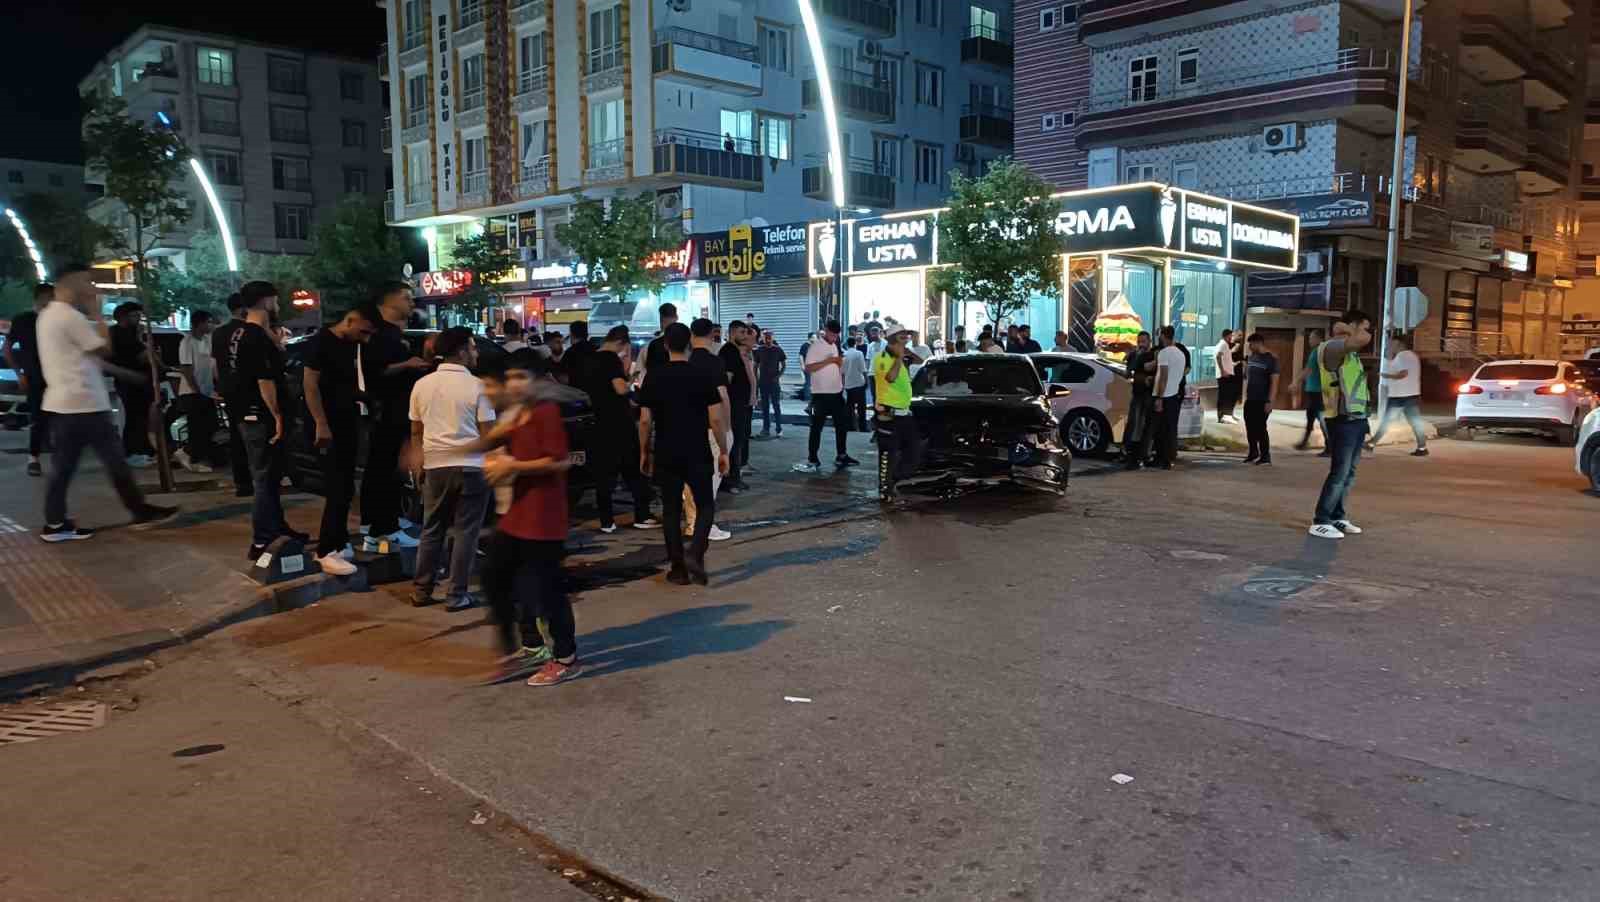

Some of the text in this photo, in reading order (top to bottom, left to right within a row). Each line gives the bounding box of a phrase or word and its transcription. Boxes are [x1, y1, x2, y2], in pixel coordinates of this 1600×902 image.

[763, 225, 806, 243] Telefon
[859, 219, 927, 242] ERHAN
[1192, 227, 1222, 248] USTA
[704, 239, 725, 253] BAY
[867, 243, 918, 263] USTA
[704, 247, 766, 275] mobile
